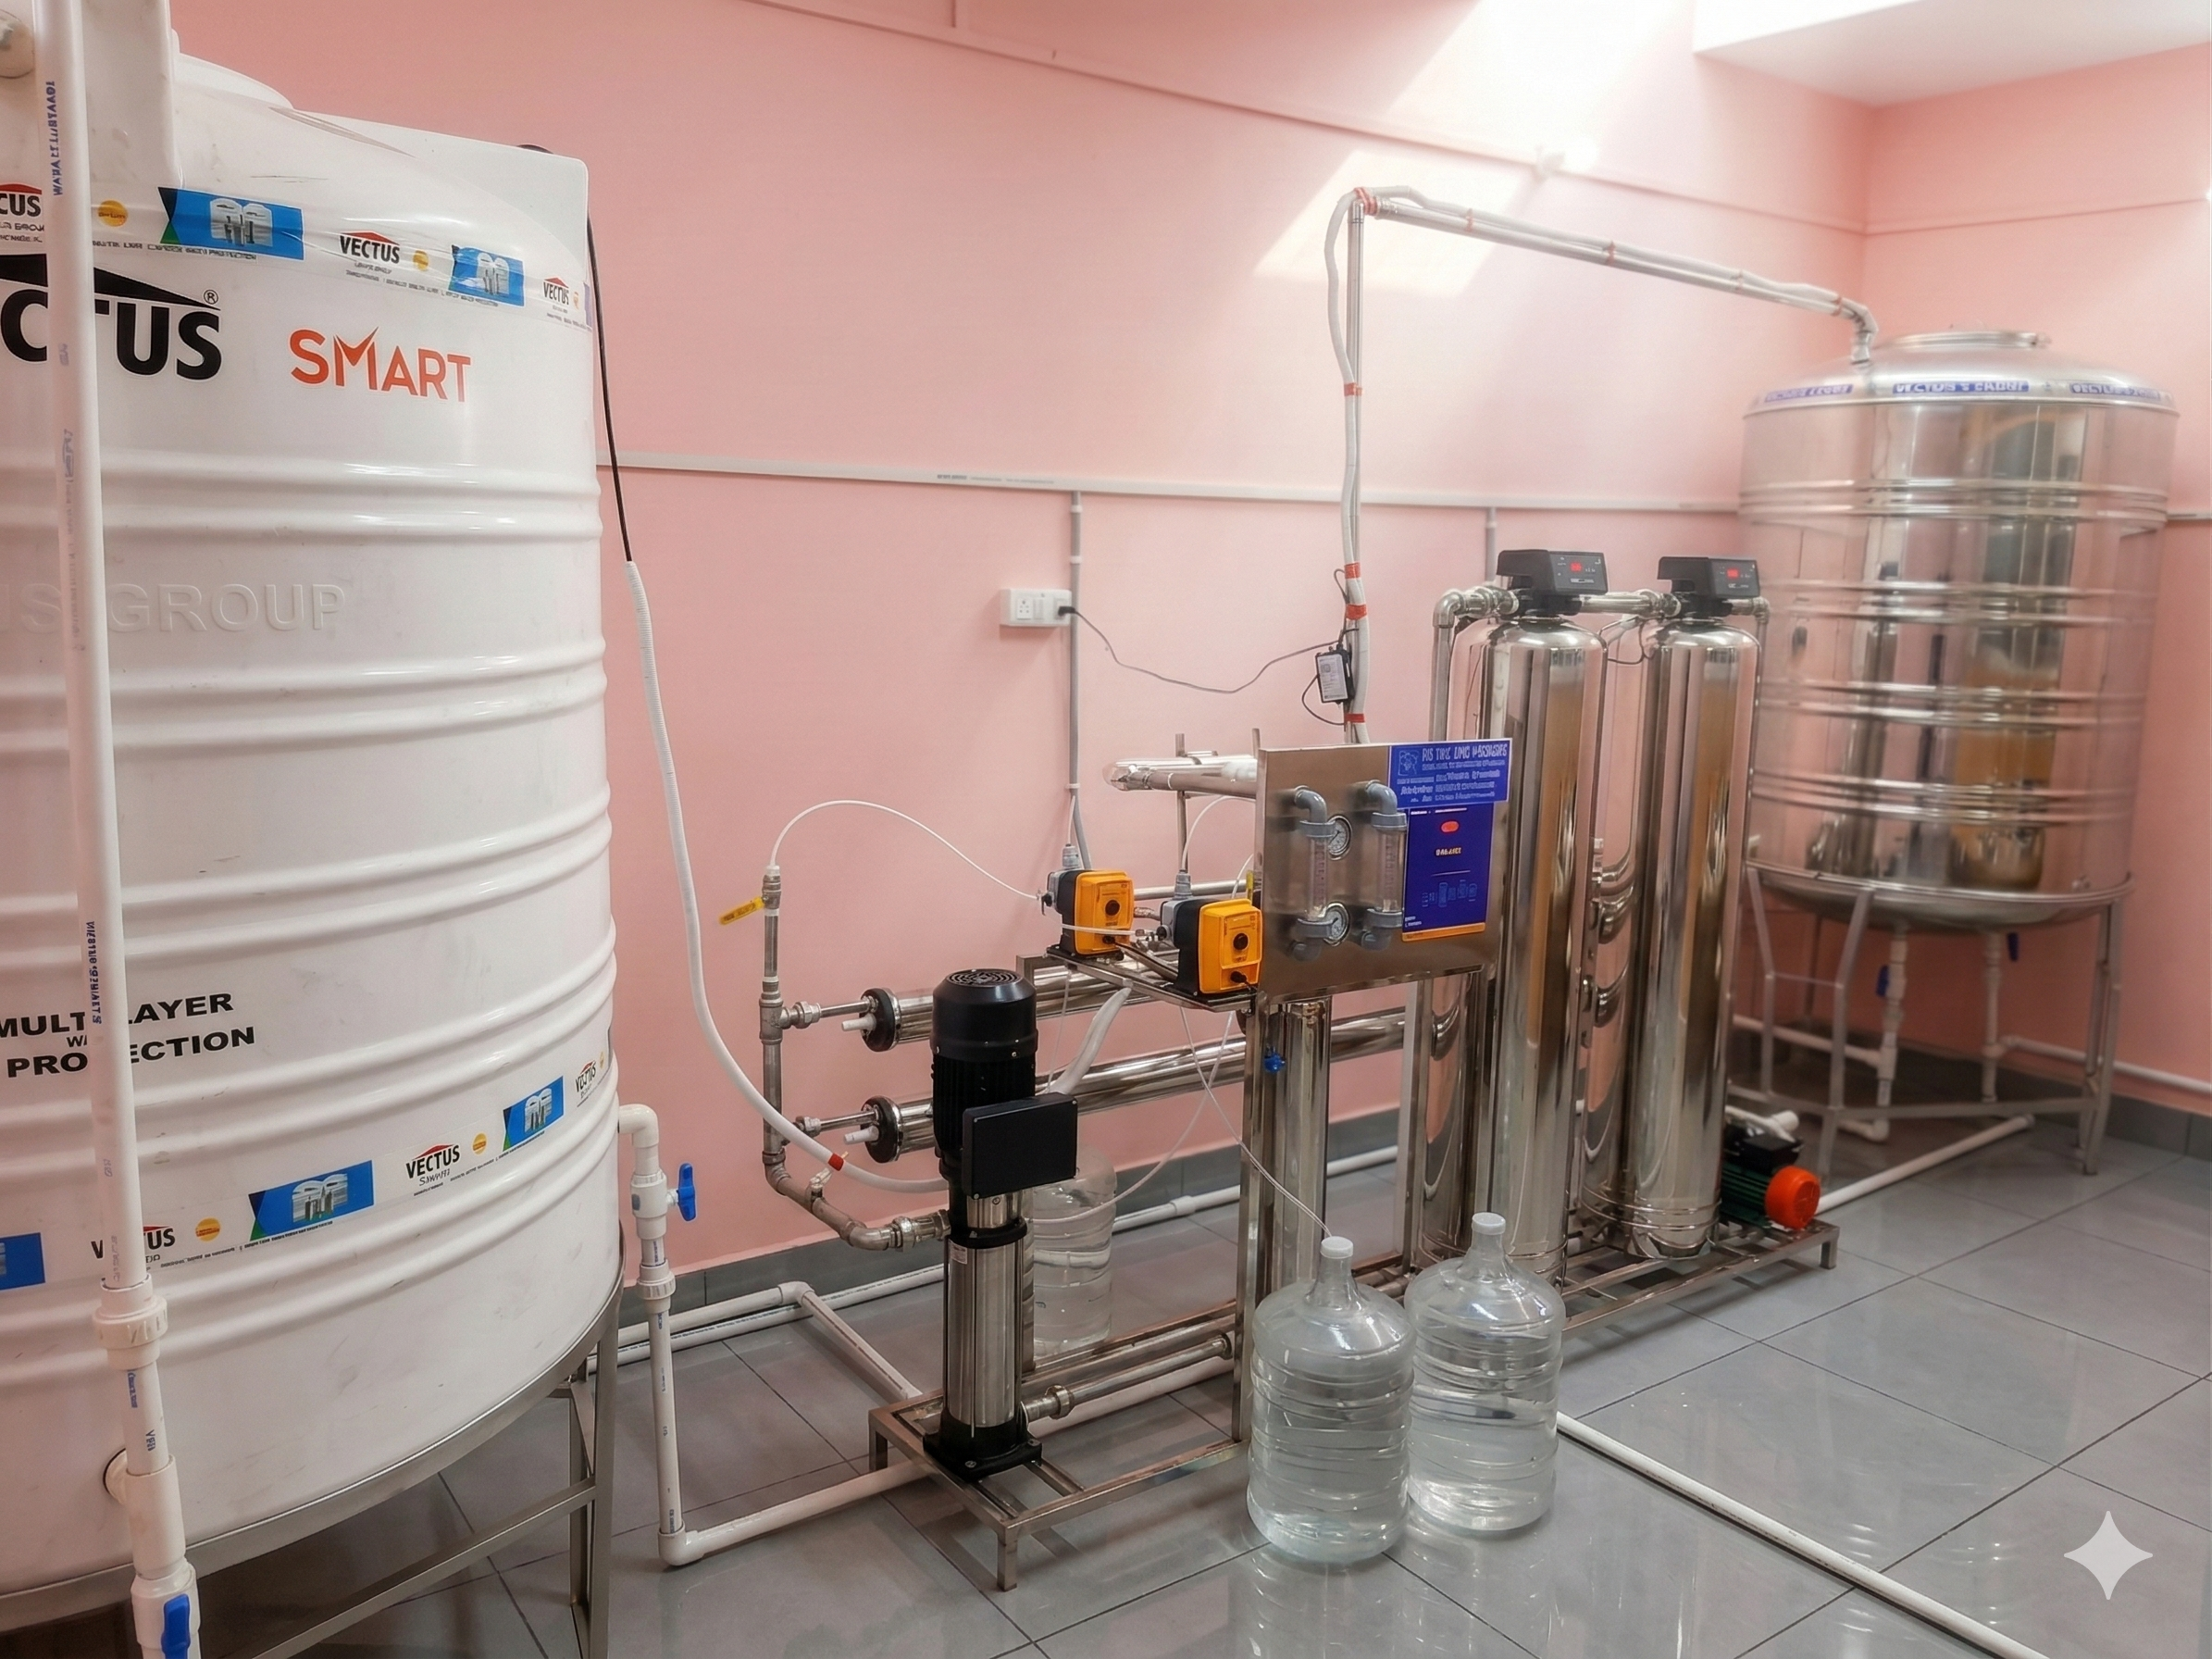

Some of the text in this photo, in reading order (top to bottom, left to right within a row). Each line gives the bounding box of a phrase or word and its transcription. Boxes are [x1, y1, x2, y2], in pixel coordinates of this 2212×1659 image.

[340, 235, 401, 264] VECTUS
[289, 326, 472, 403] SMART
[106, 582, 346, 632] GROUP
[405, 1144, 460, 1179] VECTUS
